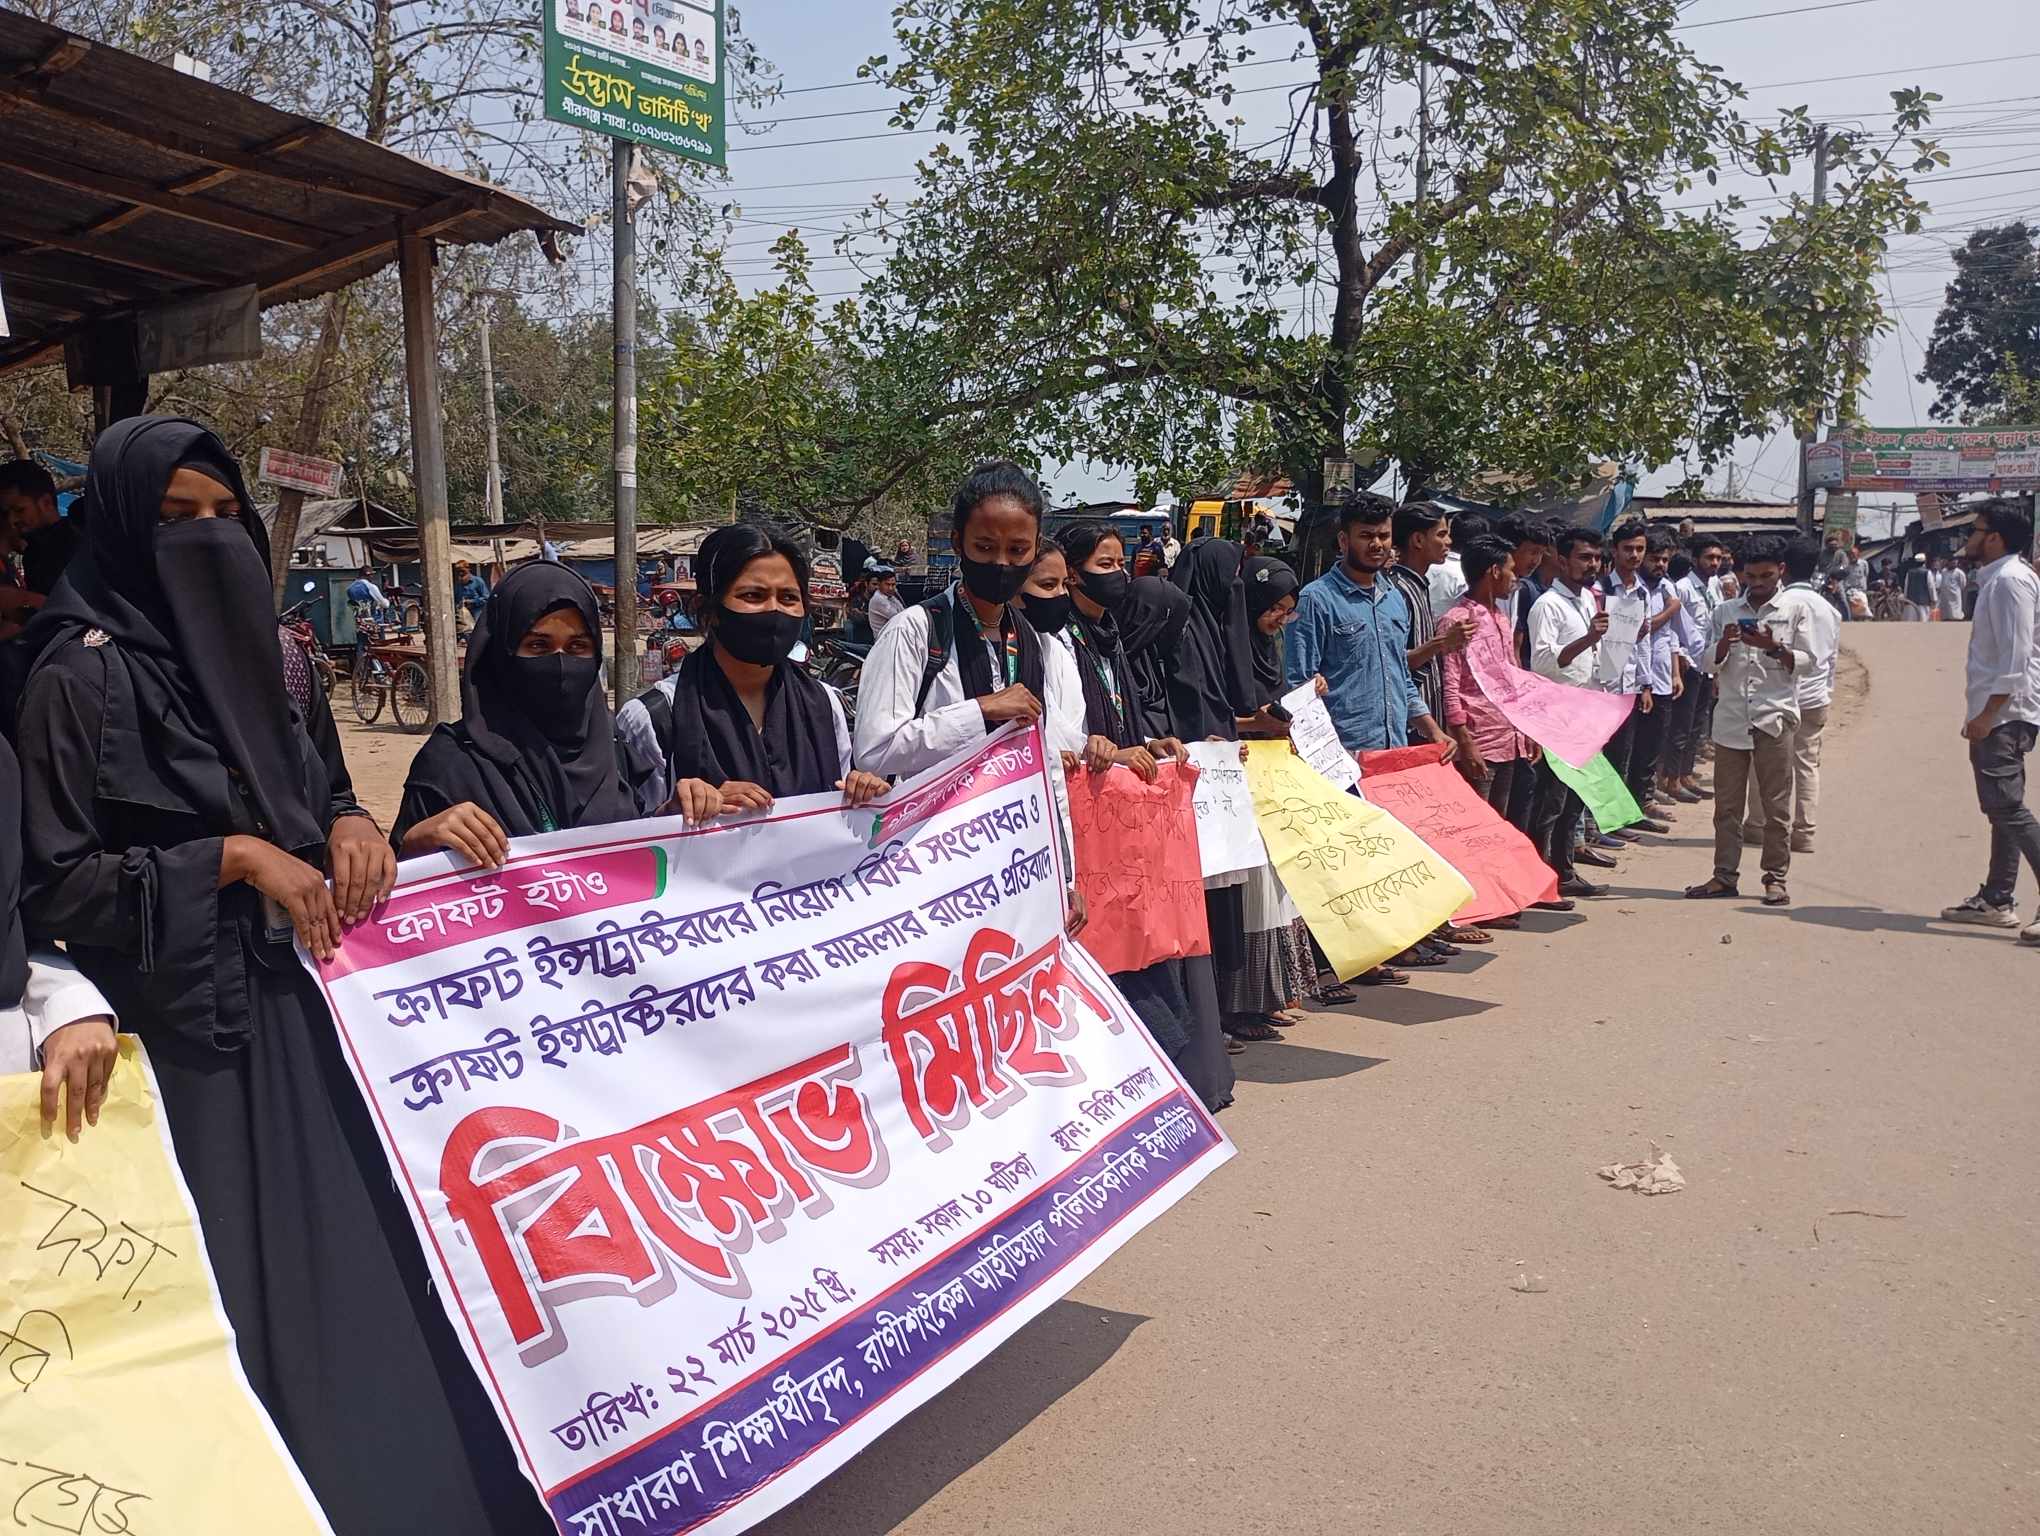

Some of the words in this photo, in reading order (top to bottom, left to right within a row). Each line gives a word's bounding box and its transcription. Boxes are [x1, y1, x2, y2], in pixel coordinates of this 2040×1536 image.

[561, 55, 635, 110] উদ্ভাস
[562, 96, 601, 125] পীরগঞ্জ
[602, 112, 626, 131] শাখা
[977, 745, 1034, 779] বাঁচাও
[374, 947, 524, 1027] ক্রাফট
[750, 872, 856, 931] নিয়োগ
[853, 840, 922, 896] বিধি
[916, 799, 1029, 865] সংশোধন
[1029, 794, 1041, 824] ও
[376, 884, 506, 944] ক্রাফট
[519, 869, 610, 913] হটাও
[389, 1027, 525, 1112] ক্রাফট
[754, 949, 821, 992] করা
[812, 911, 929, 970] মামলার
[919, 873, 1001, 928] রায়ের
[1002, 845, 1055, 899] প্রতিবাদে
[438, 1041, 885, 1356] বিক্ষোভ
[881, 927, 1120, 1146] মিছিল
[550, 1381, 660, 1451] তারিখ:
[667, 1354, 717, 1397] ২২
[707, 1306, 756, 1367] মার্চ
[761, 1287, 827, 1341] ২০২৫
[868, 1227, 924, 1266] সময়:
[915, 1199, 972, 1237] সকাল
[961, 1188, 993, 1214] ১০
[984, 1151, 1038, 1194] ঘটিকা
[1050, 1120, 1091, 1152] স্থান:
[566, 1449, 704, 1536] সাধারণ
[856, 1276, 976, 1374] রাণীশংকৈল
[963, 1219, 1058, 1292] আইডিয়াল
[1048, 1146, 1150, 1229] পলিটেকনিক
